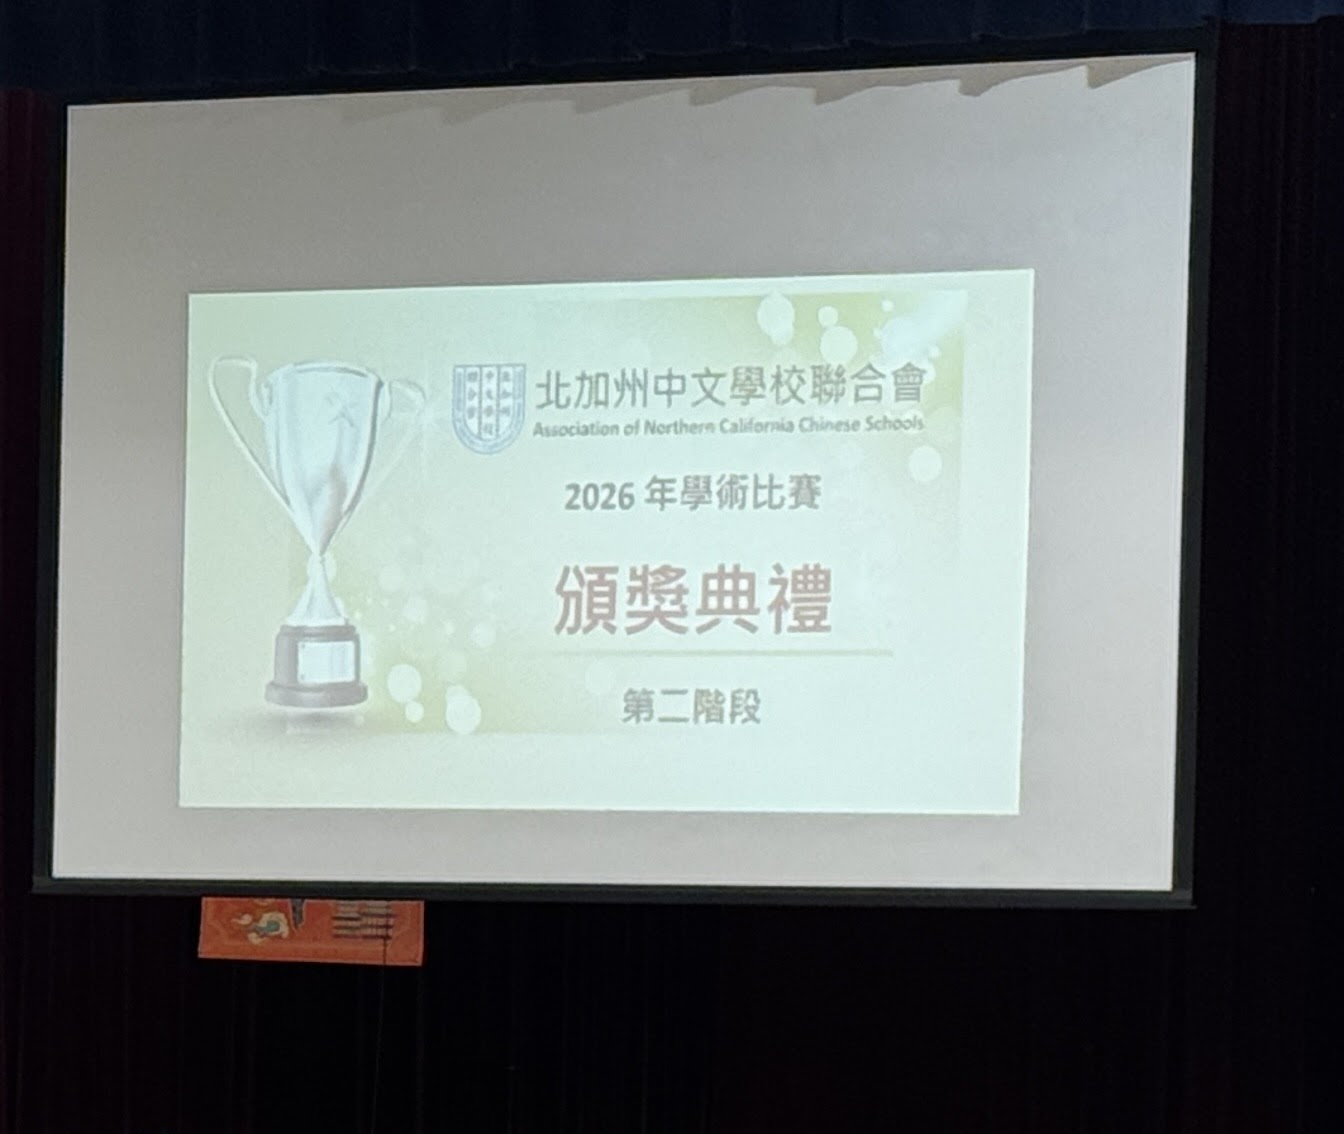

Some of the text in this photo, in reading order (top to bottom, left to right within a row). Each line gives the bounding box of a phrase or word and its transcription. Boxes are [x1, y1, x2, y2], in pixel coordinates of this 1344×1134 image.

[535, 362, 927, 409] 北加州中文學校聯合會
[532, 415, 925, 438] Association of Northern California Chinese Schools
[564, 473, 822, 512] 2026 年學術比賽
[554, 563, 832, 635] 頒獎典禮
[622, 688, 761, 724] 第二階段
